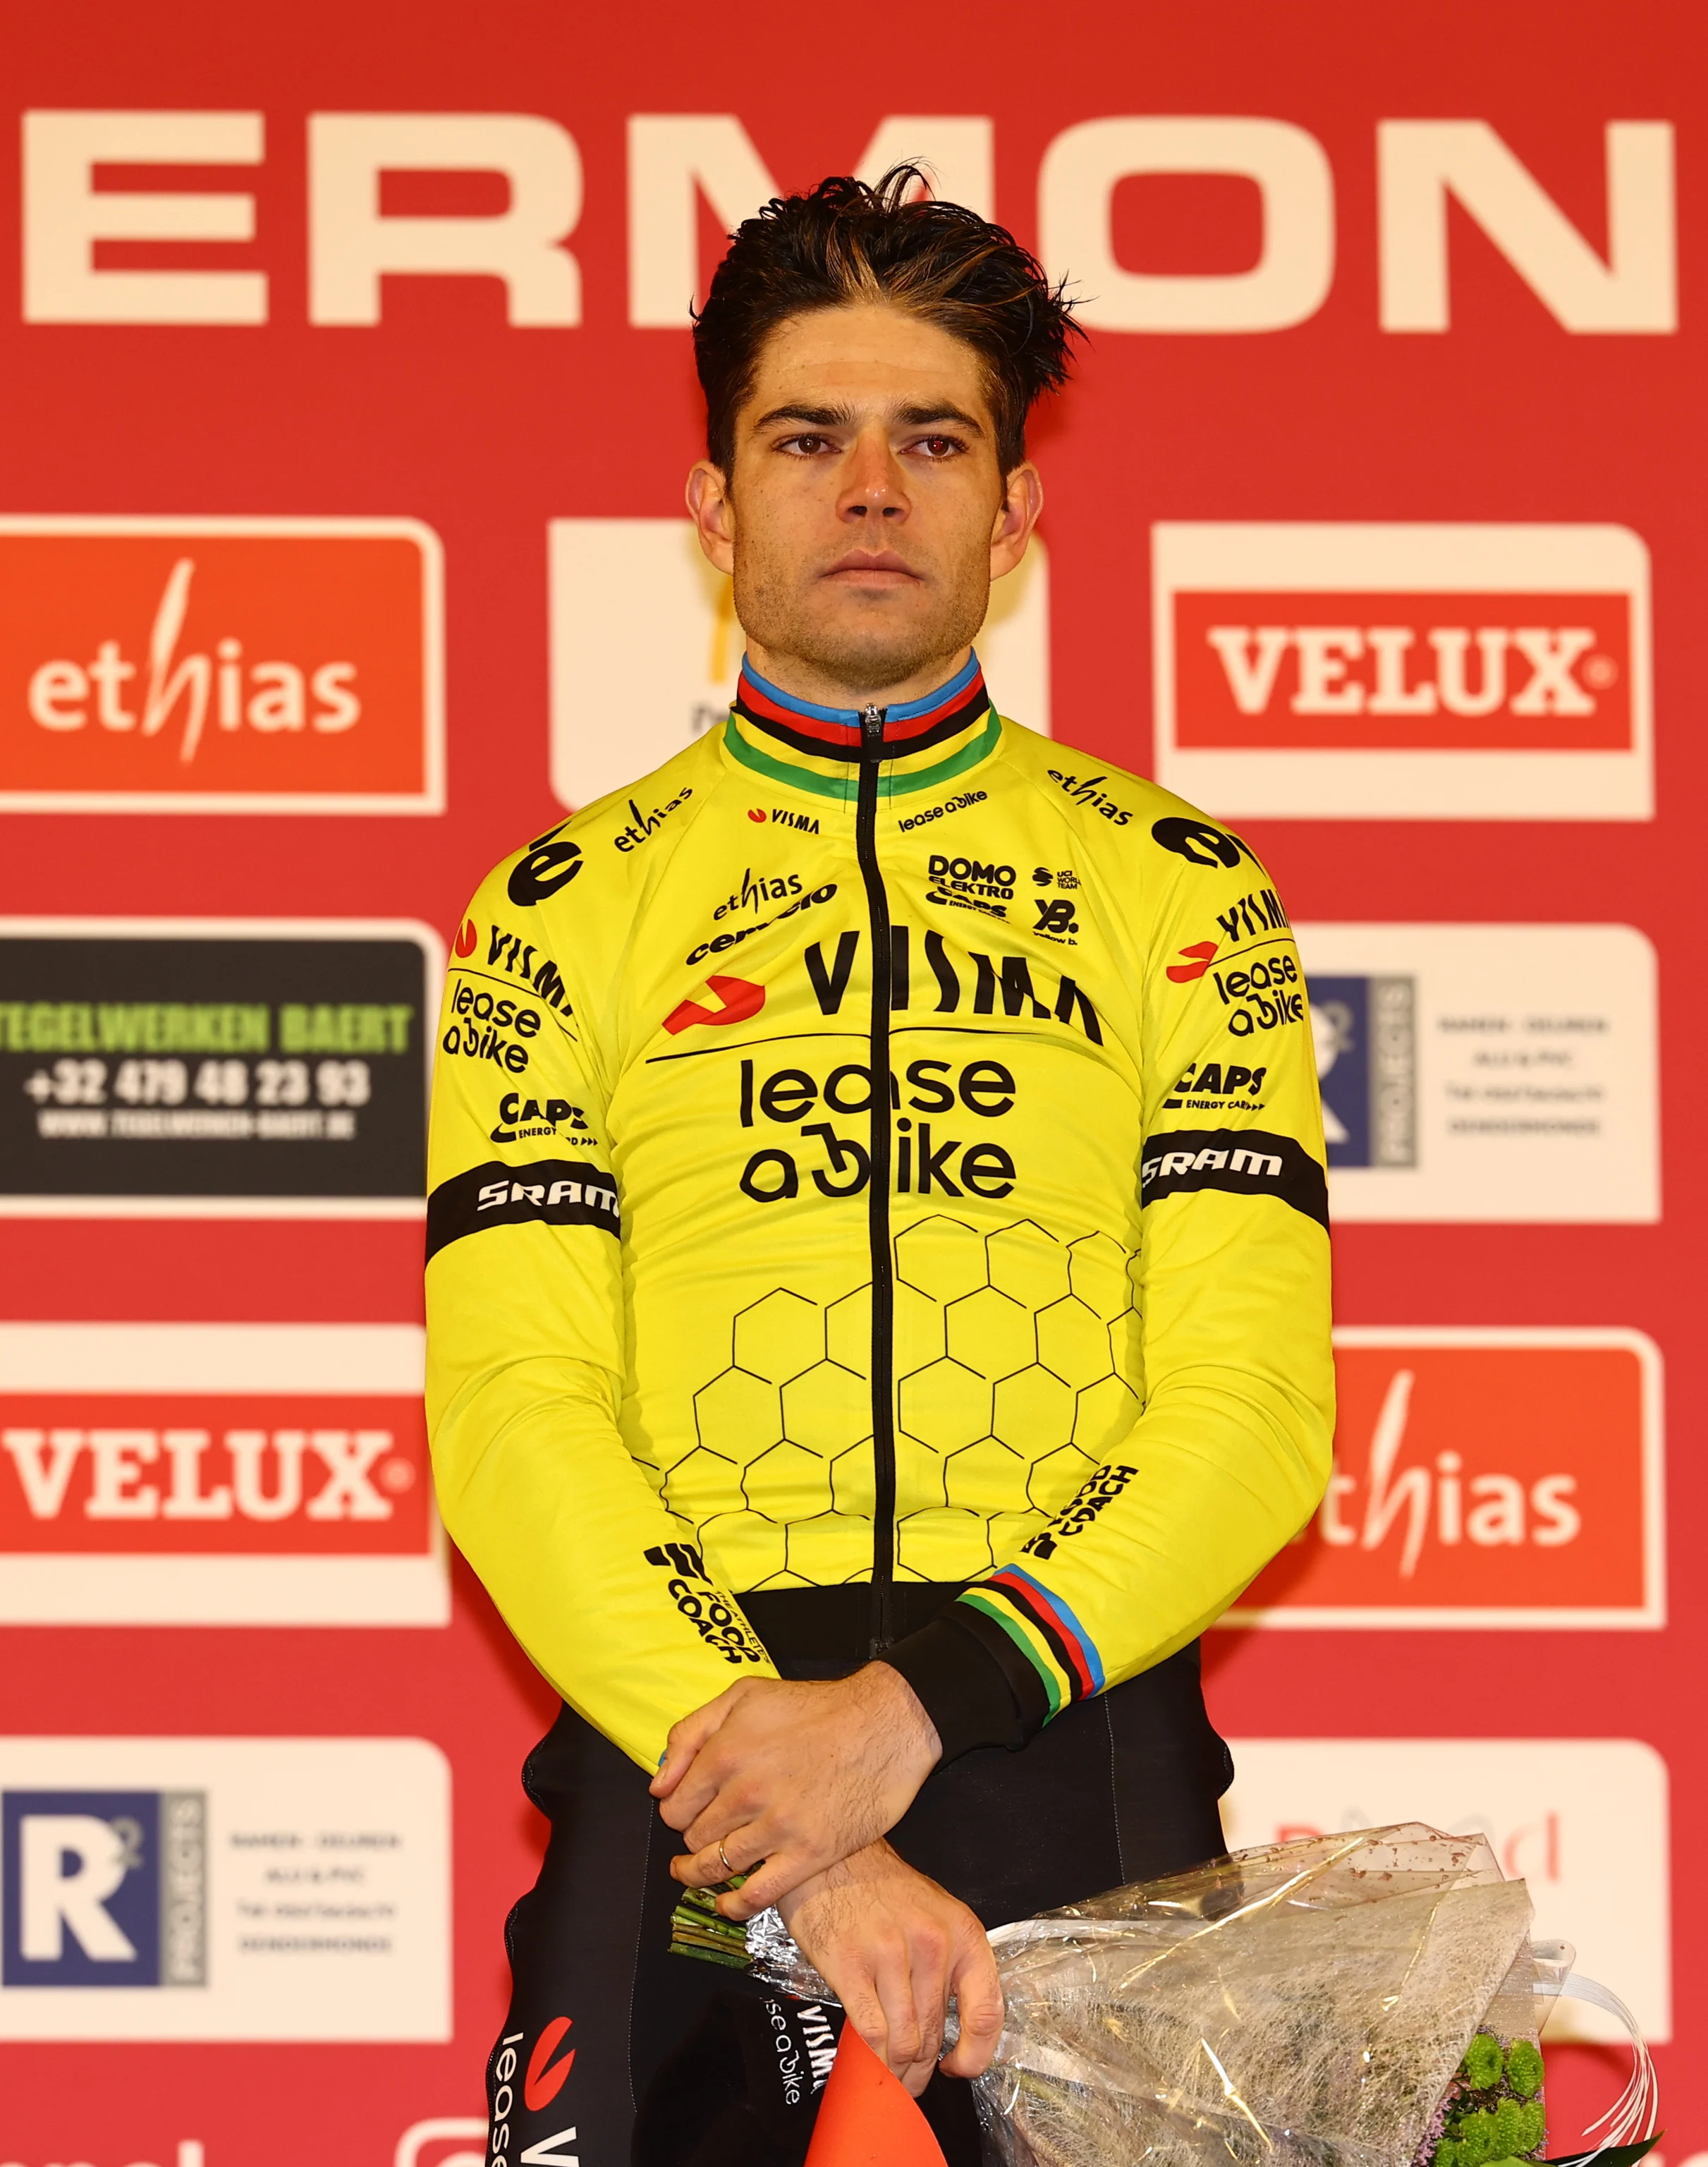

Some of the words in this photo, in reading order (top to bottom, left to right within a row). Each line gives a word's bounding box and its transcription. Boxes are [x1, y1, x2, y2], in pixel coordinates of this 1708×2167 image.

[28, 558, 361, 766] ethias
[614, 787, 693, 852] ethias
[771, 808, 819, 835] VISMA
[898, 806, 944, 833] lease
[1047, 769, 1133, 825] ethias
[713, 867, 803, 921] ethias
[928, 854, 1016, 887] DOMO
[928, 875, 1014, 900] ELEKTRO
[804, 925, 1104, 1048] VISMA
[1212, 954, 1298, 1006] lease
[280, 1004, 413, 1055] BAERT
[451, 978, 542, 1039] lease
[255, 1060, 310, 1105] 23
[740, 1058, 1017, 1129] lease
[1186, 1099, 1226, 1110] ENERGY
[518, 1126, 558, 1139] ENERGY
[1142, 1148, 1283, 1189] SRAM
[476, 1179, 621, 1219] SRAM
[1321, 1369, 1582, 1580] thias
[668, 1579, 743, 1664] COACH
